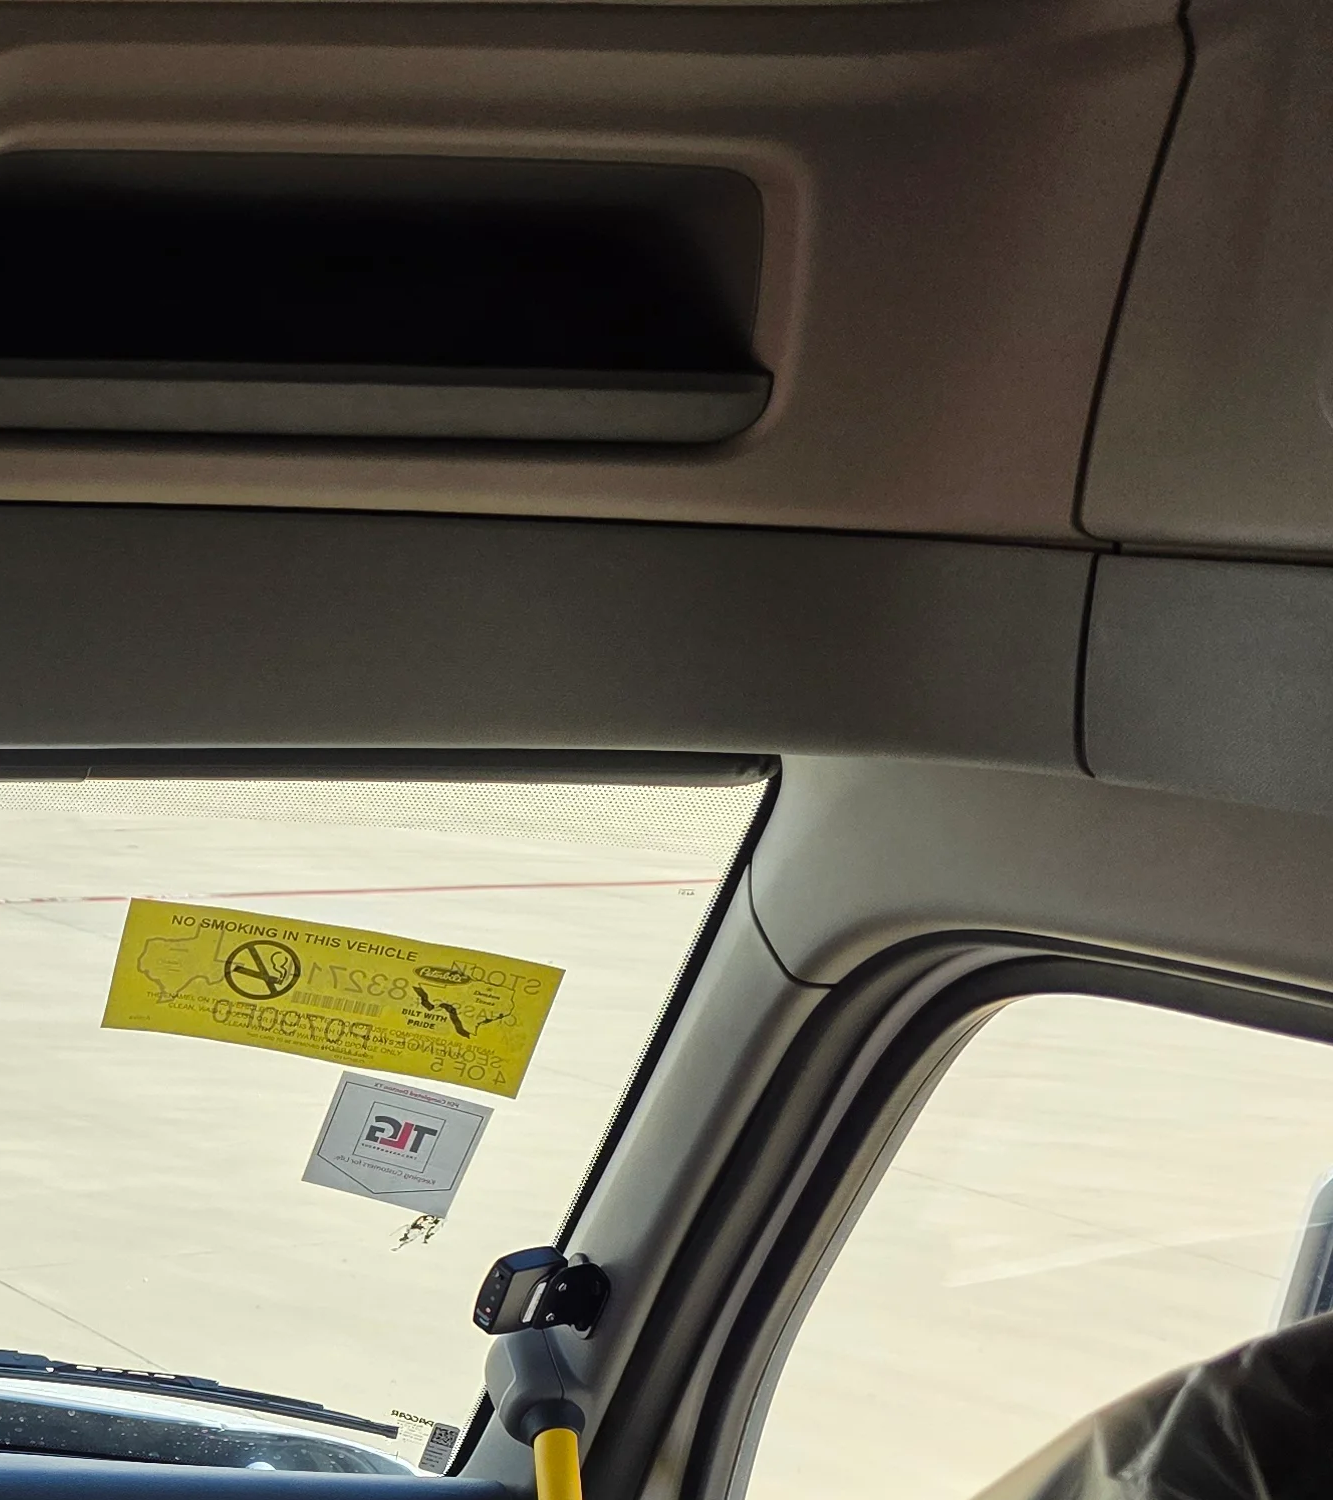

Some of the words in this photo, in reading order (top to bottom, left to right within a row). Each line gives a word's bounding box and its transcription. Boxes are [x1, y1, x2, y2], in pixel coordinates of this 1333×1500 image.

[171, 914, 196, 927] NO
[200, 918, 278, 938] SMOKING
[282, 929, 300, 942] IN
[304, 933, 341, 948] THIS
[346, 940, 419, 962] VEHICLE
[419, 967, 468, 983] Peterbilt
[401, 1007, 422, 1019] BILT
[424, 1011, 448, 1023] WITH
[406, 1019, 436, 1030] PRIDE
